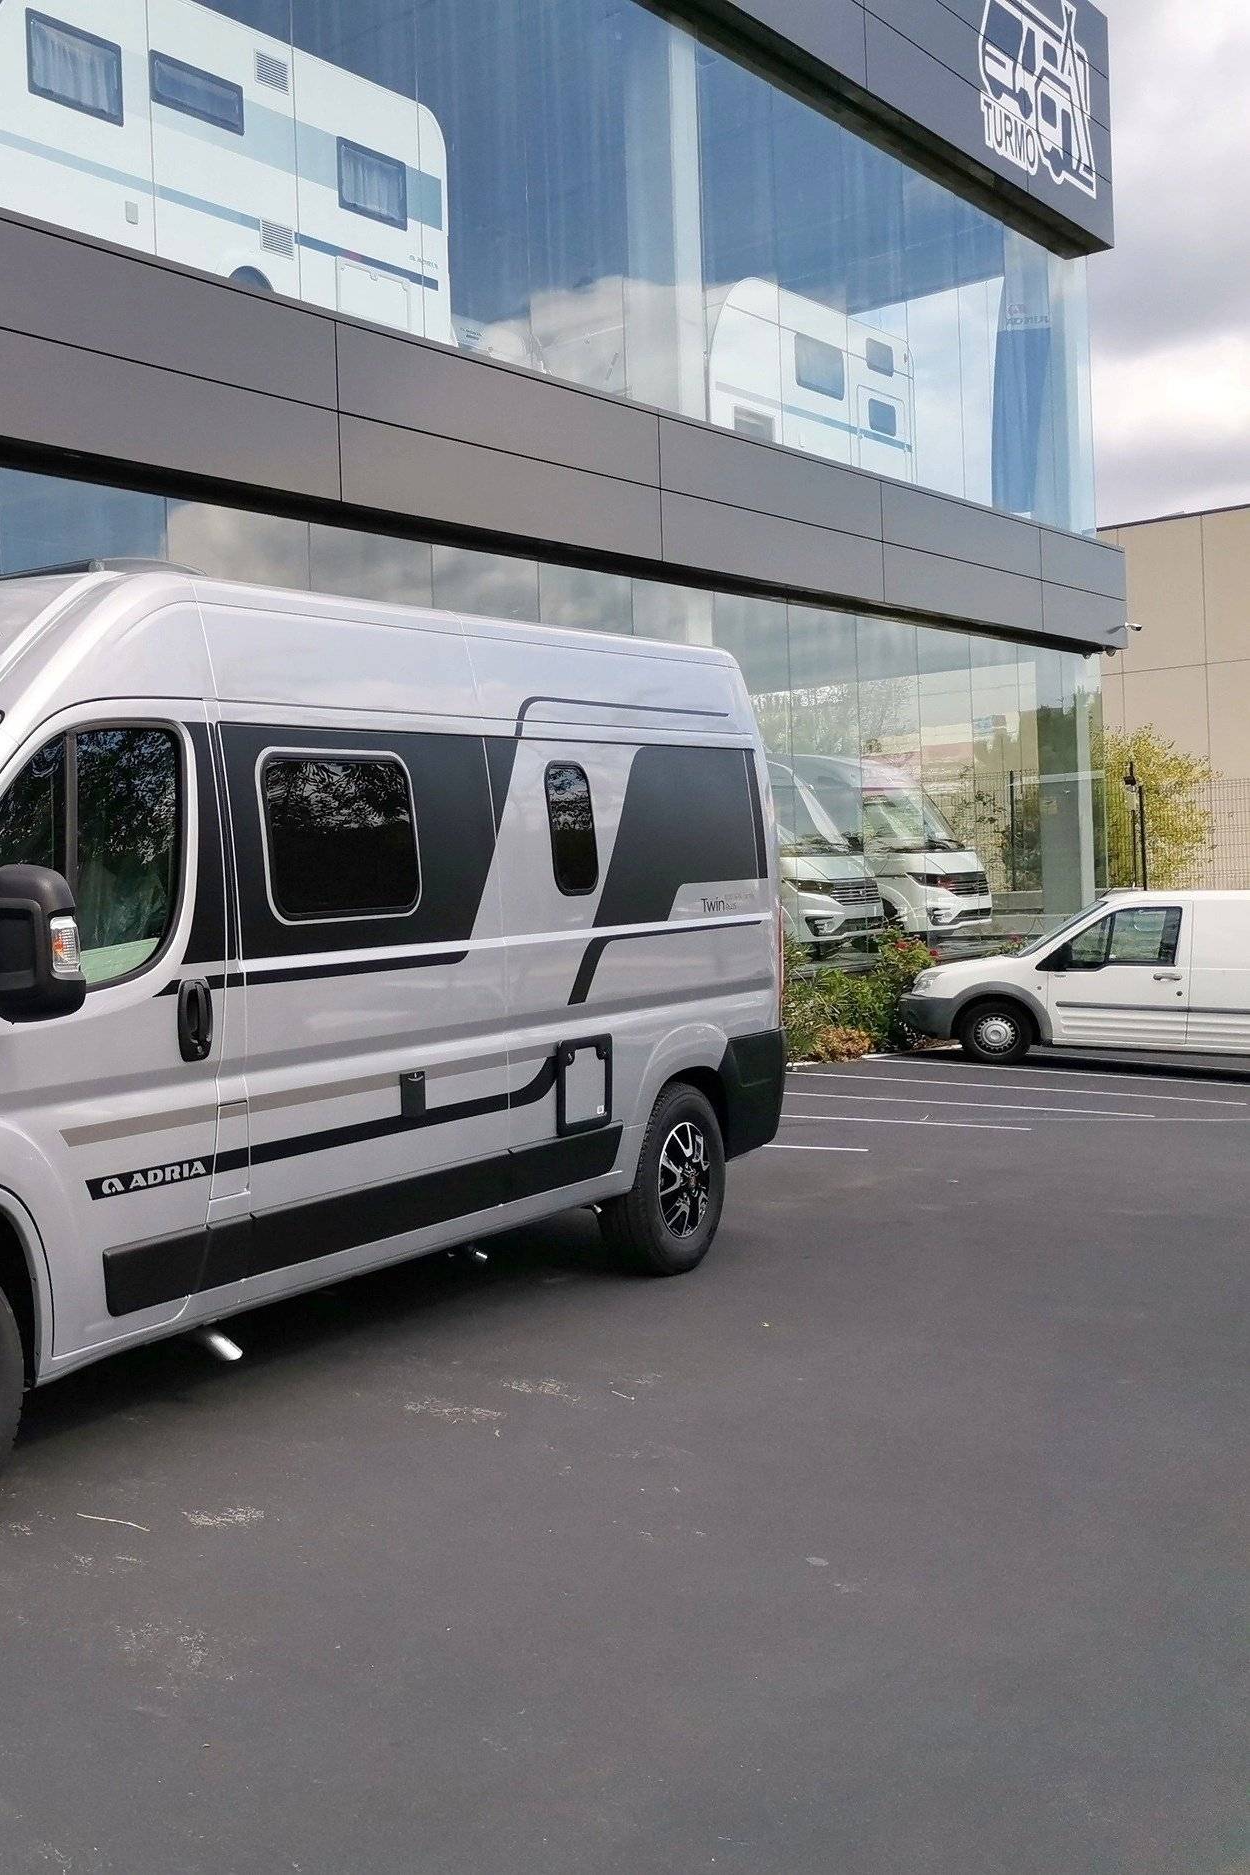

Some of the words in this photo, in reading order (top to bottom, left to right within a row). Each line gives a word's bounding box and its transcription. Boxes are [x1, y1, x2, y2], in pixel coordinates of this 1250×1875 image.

[982, 97, 1037, 172] TURMO
[701, 896, 725, 912] Twin
[129, 1160, 206, 1190] ADRIA
